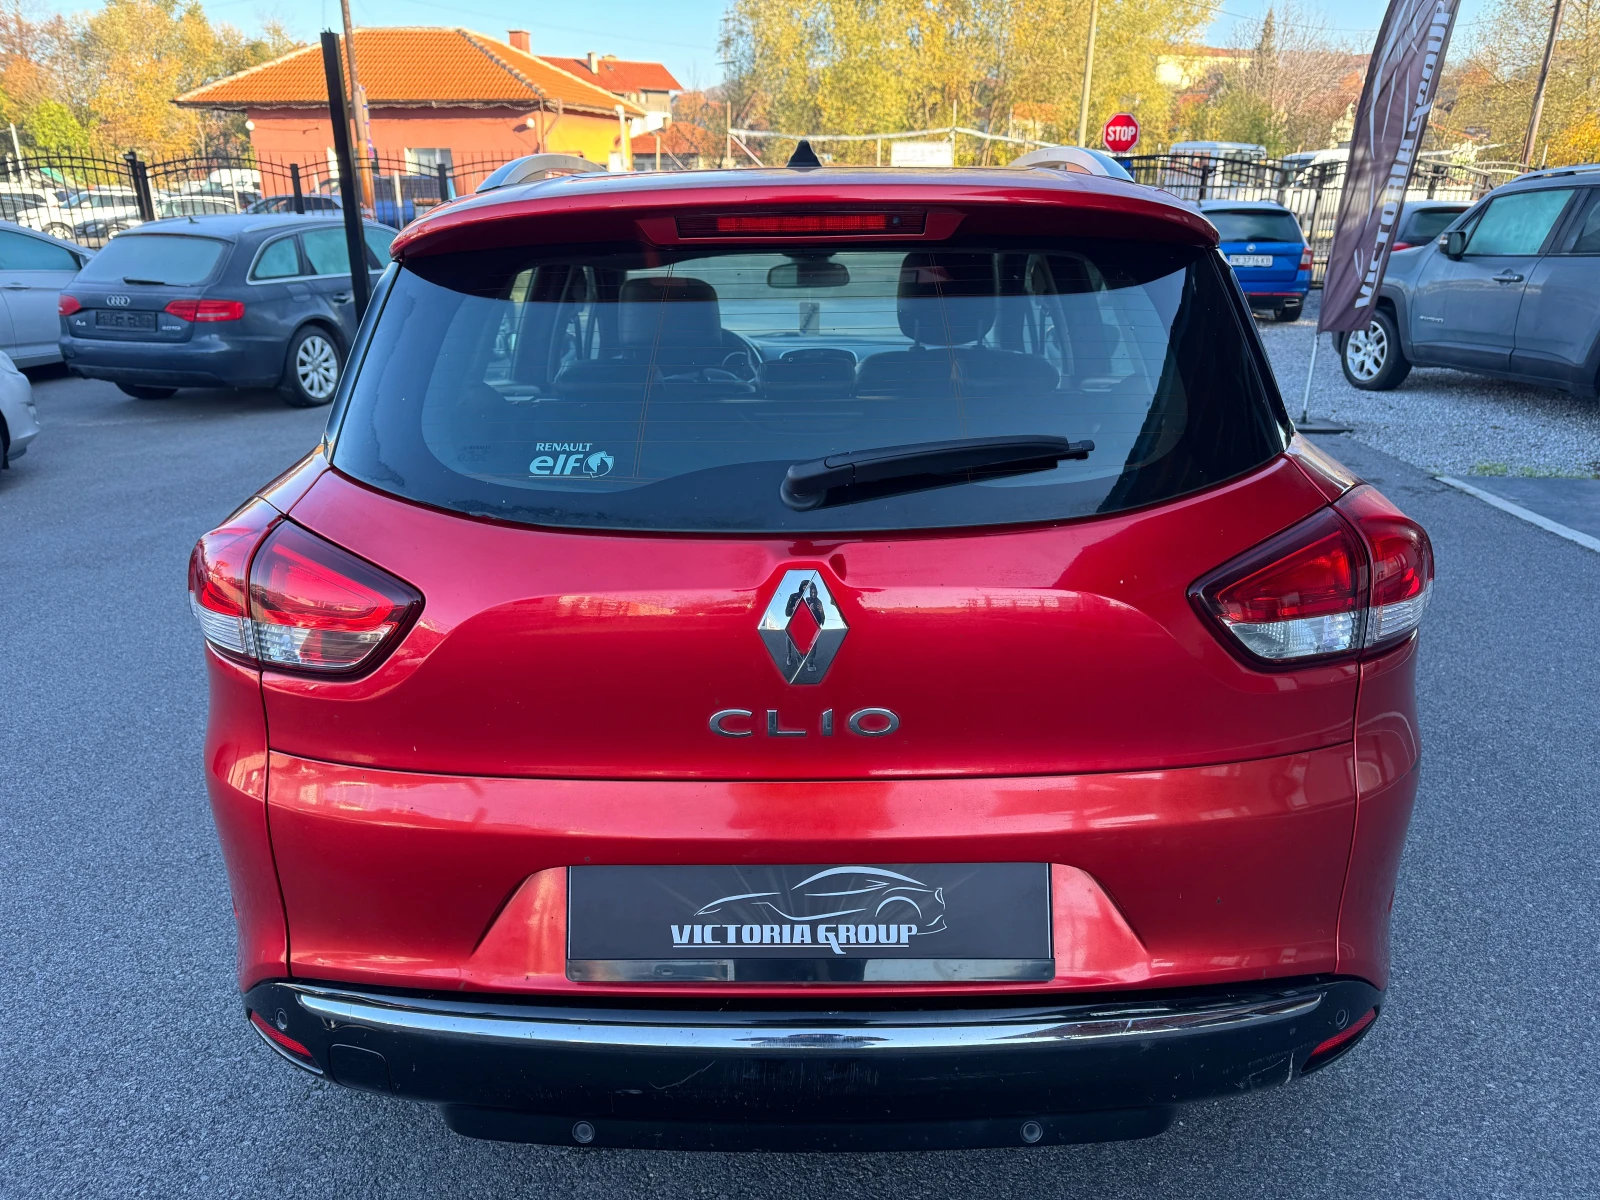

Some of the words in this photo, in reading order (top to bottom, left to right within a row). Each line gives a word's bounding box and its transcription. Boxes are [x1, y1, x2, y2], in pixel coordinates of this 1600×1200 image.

[1107, 126, 1136, 141] STOP
[1355, 139, 1414, 308] VICTORIA
[1407, 1, 1452, 132] GROUP
[535, 442, 593, 451] RENAULT
[529, 454, 584, 475] elf
[709, 708, 900, 737] CLIO
[671, 924, 812, 944] VICTORIA
[817, 924, 918, 954] GROUP
